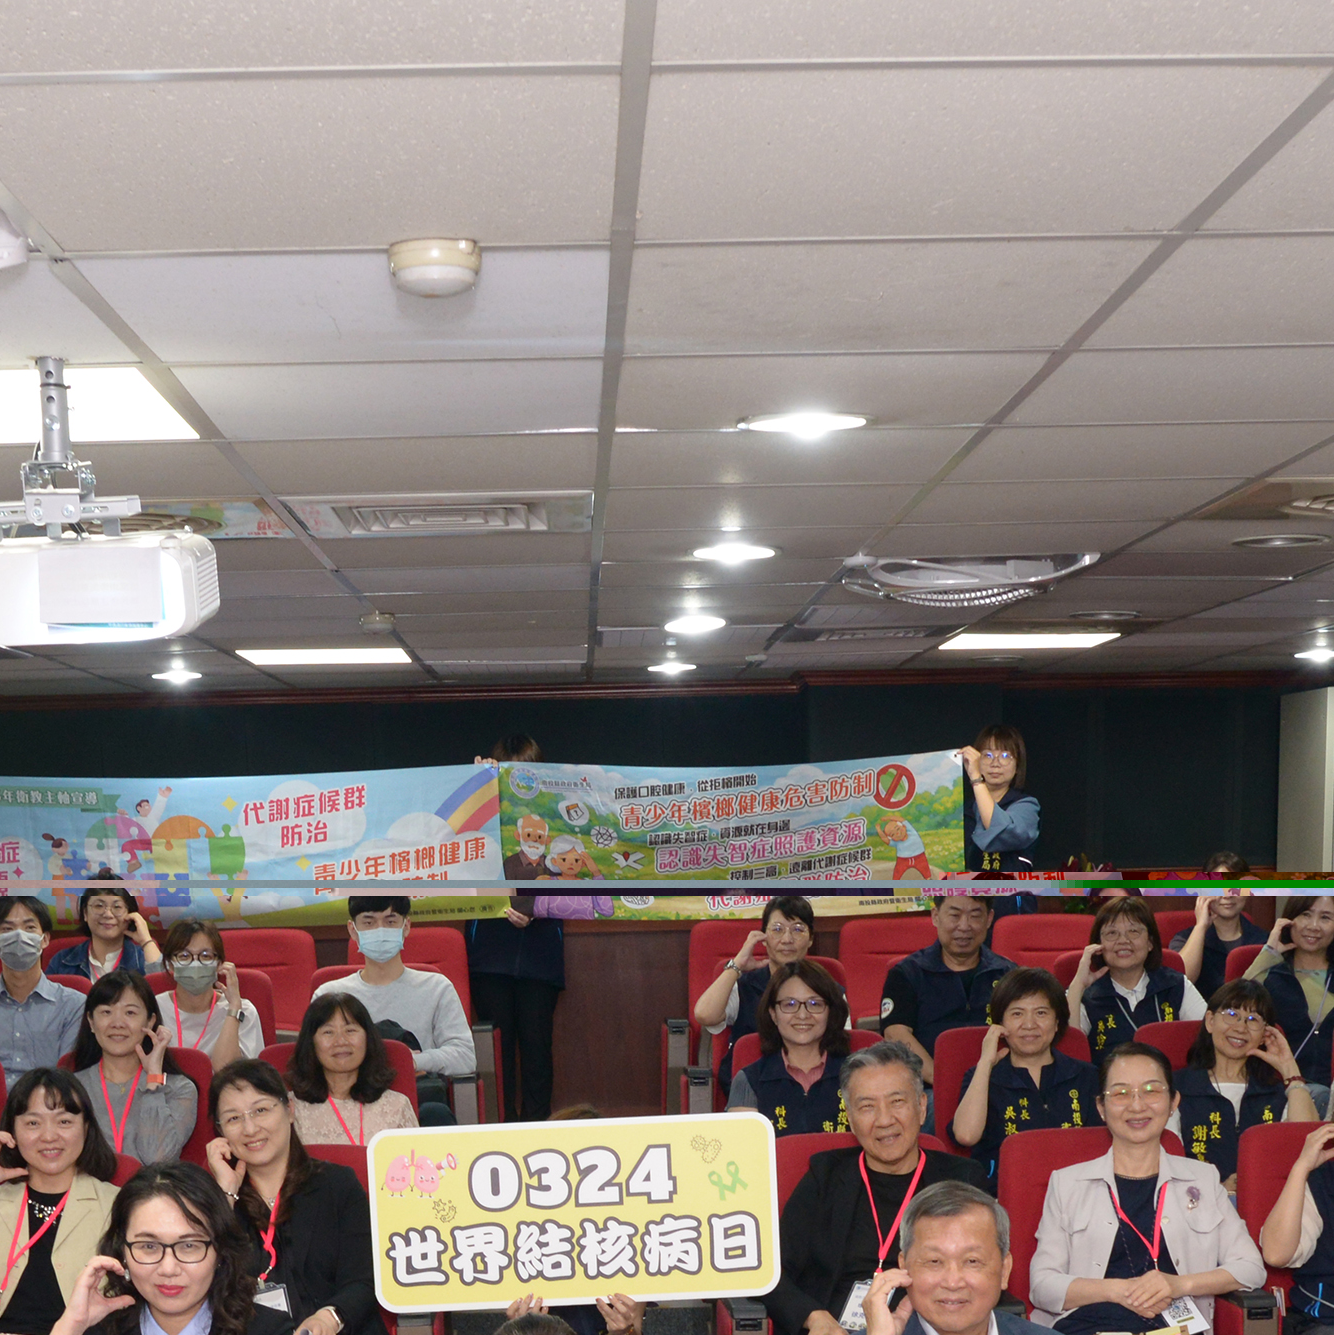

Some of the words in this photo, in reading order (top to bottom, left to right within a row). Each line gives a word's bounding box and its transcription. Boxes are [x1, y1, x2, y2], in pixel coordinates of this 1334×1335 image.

[243, 784, 366, 826] 代謝症候群
[622, 770, 875, 829] 青少年檳榔健康危害防制
[280, 820, 328, 848] 防治
[657, 821, 864, 870] 認識失智症照護資源
[313, 837, 486, 895] 青少年檳榔健康
[1209, 1112, 1222, 1139] 科長
[467, 1144, 677, 1212] 0324
[386, 1210, 763, 1288] 世界結核病日
